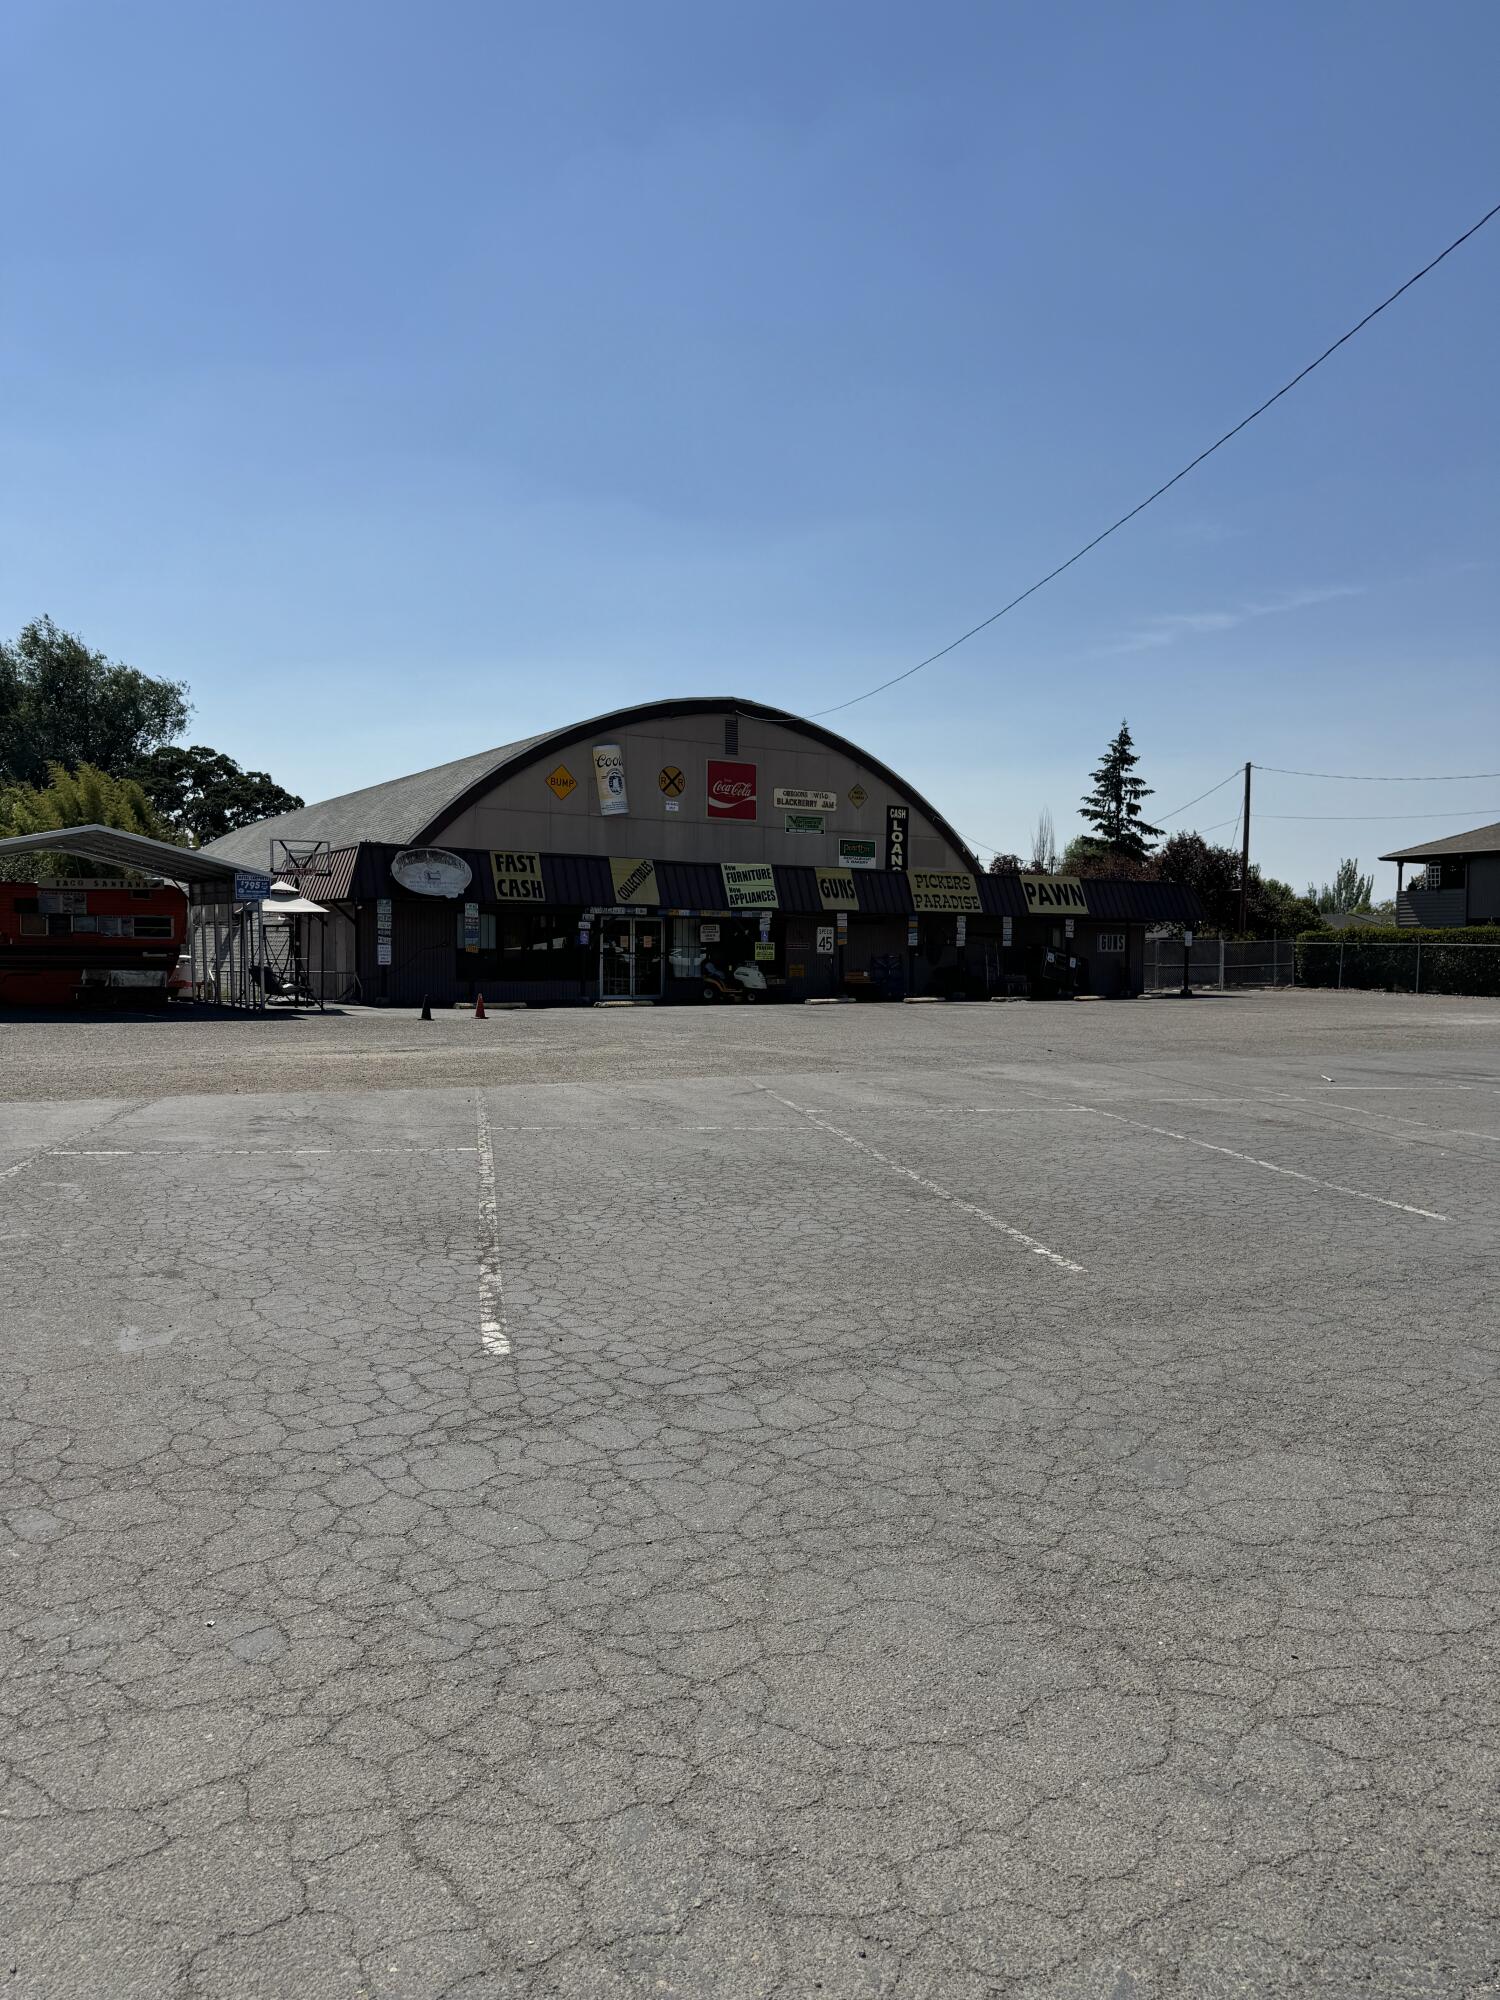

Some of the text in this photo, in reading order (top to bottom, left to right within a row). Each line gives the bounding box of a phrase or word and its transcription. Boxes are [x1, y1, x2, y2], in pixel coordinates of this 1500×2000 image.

[550, 777, 574, 788] BUMP
[776, 798, 835, 809] BLACKBERRY JAM
[890, 808, 906, 819] CASH
[494, 853, 536, 873] FAST
[94, 880, 149, 888] SANTANA
[617, 860, 653, 900] COLLECTIBLES
[726, 868, 772, 884] FURNITURE
[914, 874, 971, 890] PICKERS
[497, 879, 544, 899] CASH
[820, 878, 856, 899] GUNS
[1023, 882, 1086, 907] PAWN
[729, 889, 776, 906] APPLIANCES
[913, 894, 981, 910] PARADISE
[818, 936, 832, 951] 45
[1101, 935, 1123, 950] GUNS
